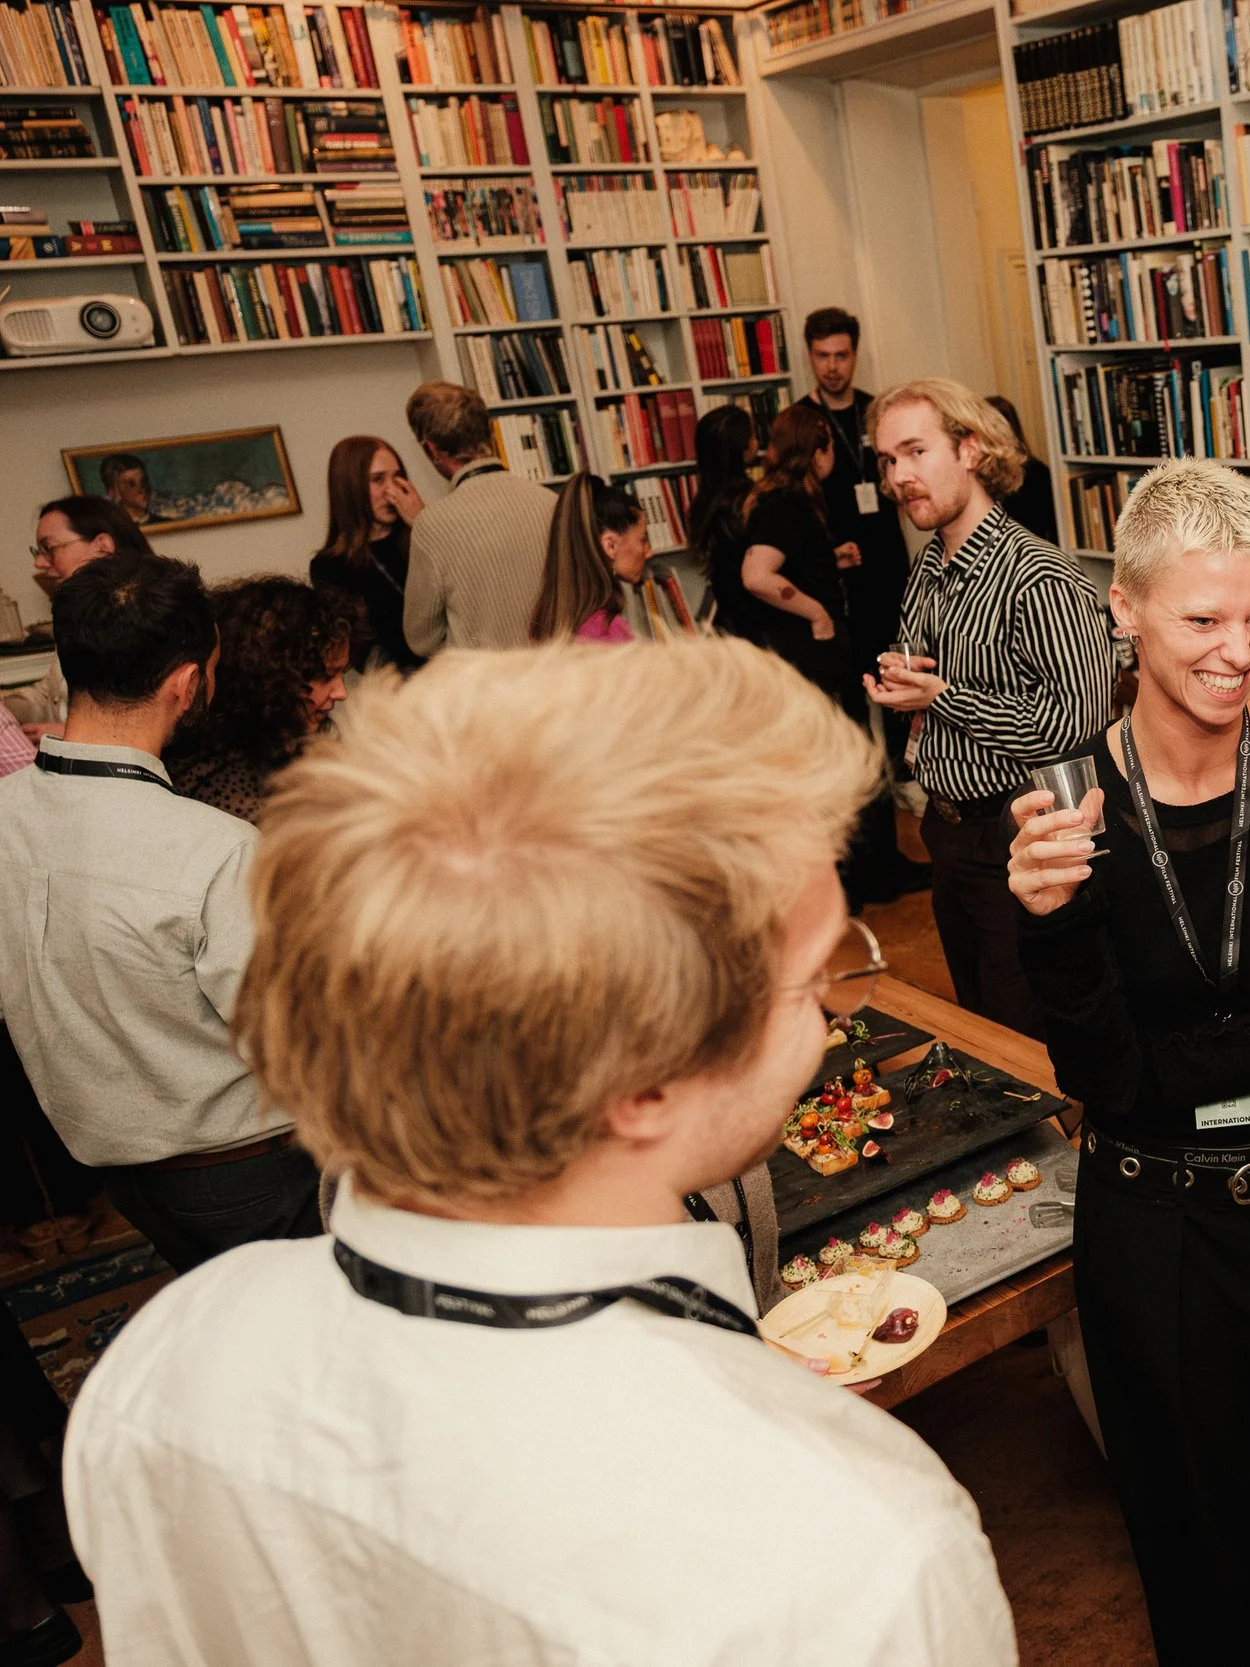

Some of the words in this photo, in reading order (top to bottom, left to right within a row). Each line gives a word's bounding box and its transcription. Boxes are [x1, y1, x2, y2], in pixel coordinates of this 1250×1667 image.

[1126, 743, 1136, 769] FESTIVAL
[1135, 782, 1145, 808] HELSINKI
[1142, 808, 1159, 852] INTERNATIONAL
[1160, 866, 1168, 880] FILM
[1165, 880, 1176, 904] FESTIVAL
[1229, 895, 1238, 940] INTERNATIONAL
[1235, 840, 1243, 866] FESTIVAL
[1178, 916, 1190, 941] HELSINKI
[1184, 1152, 1219, 1163] Calvin
[1221, 1153, 1246, 1163] Klein
